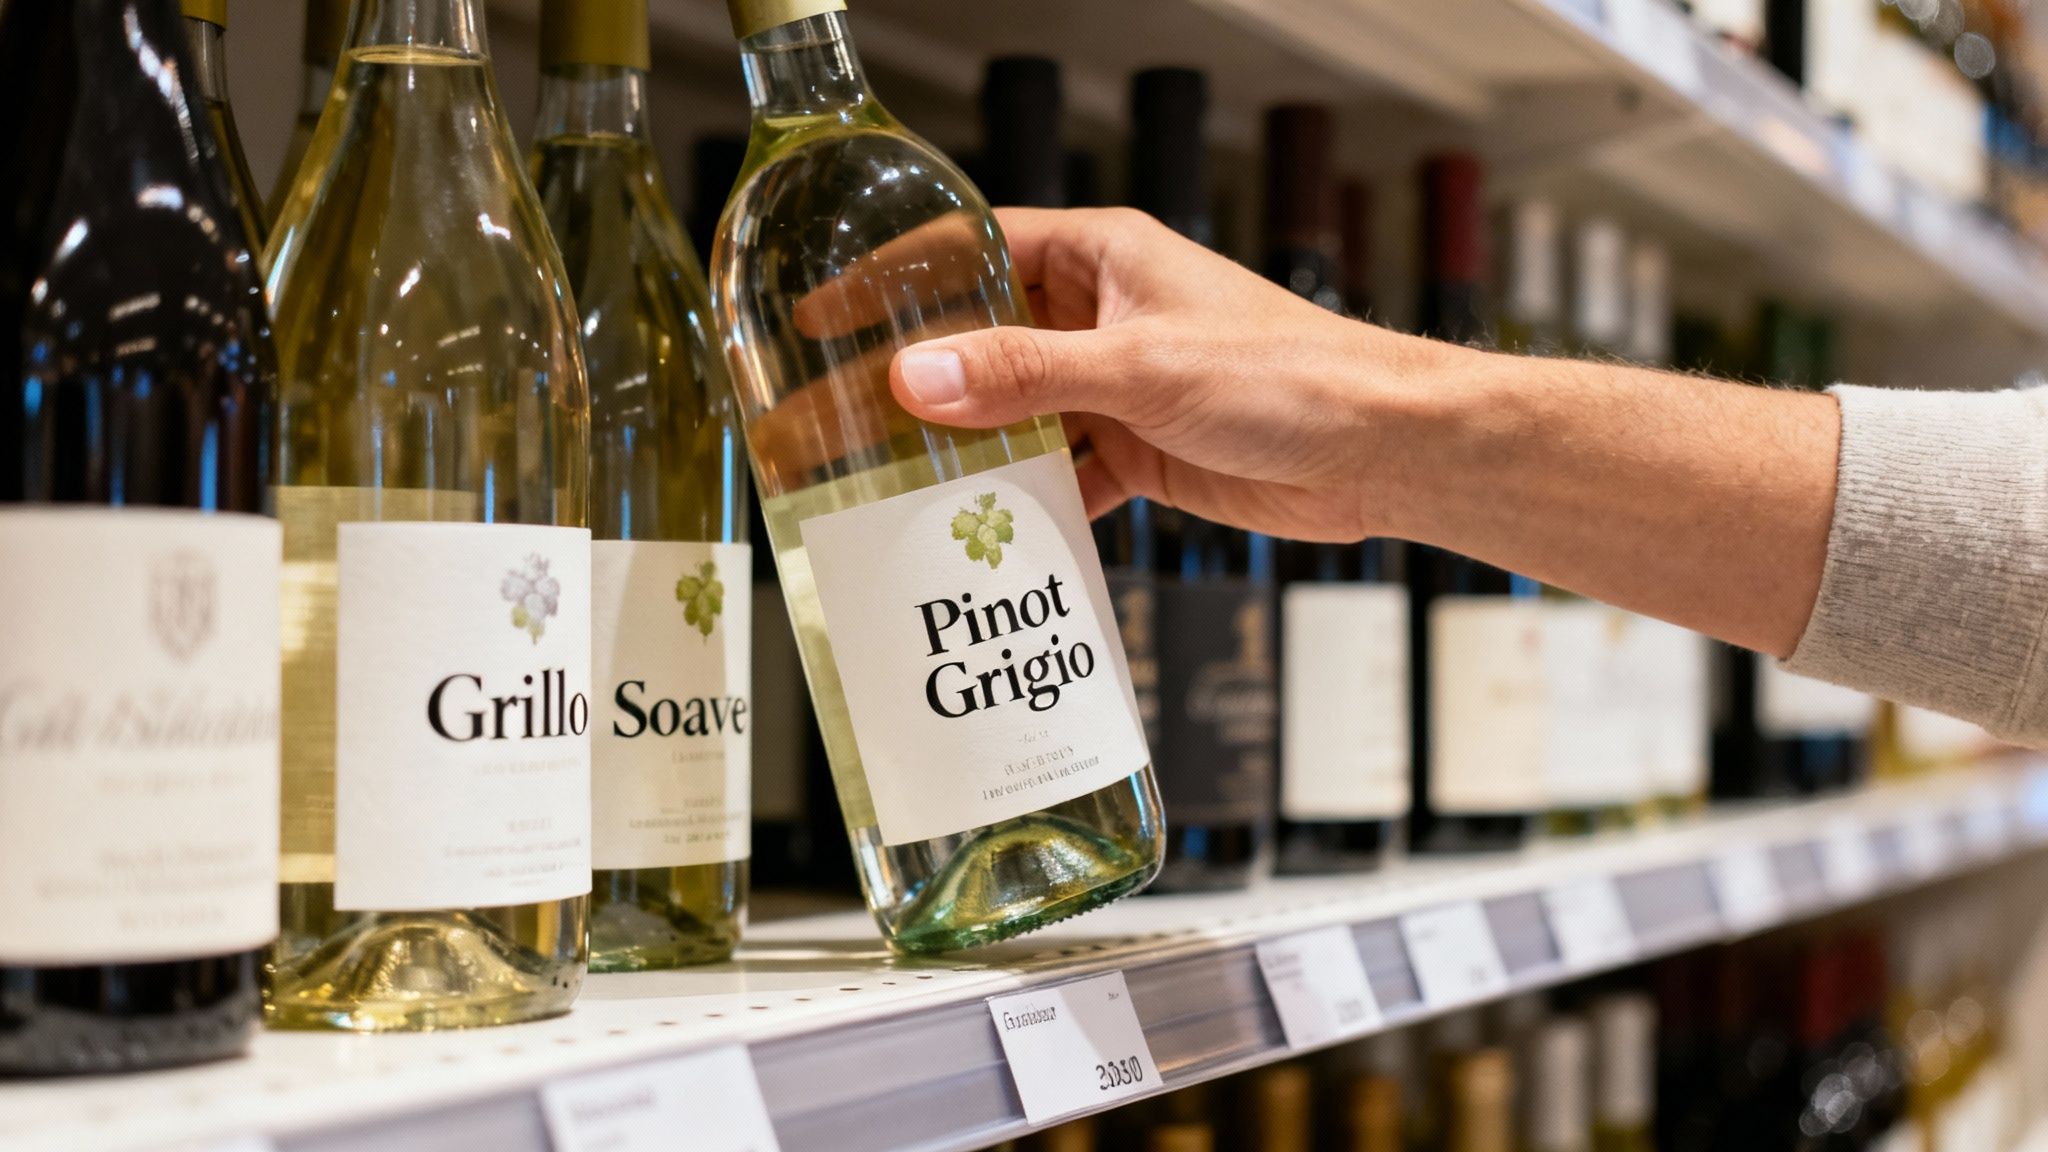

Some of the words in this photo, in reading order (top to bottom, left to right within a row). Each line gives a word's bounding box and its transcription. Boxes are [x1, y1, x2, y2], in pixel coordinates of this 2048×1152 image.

[914, 573, 1070, 657] Pinot
[427, 668, 589, 742] Grillo
[613, 680, 748, 739] Soave
[925, 633, 1095, 719] Grigio
